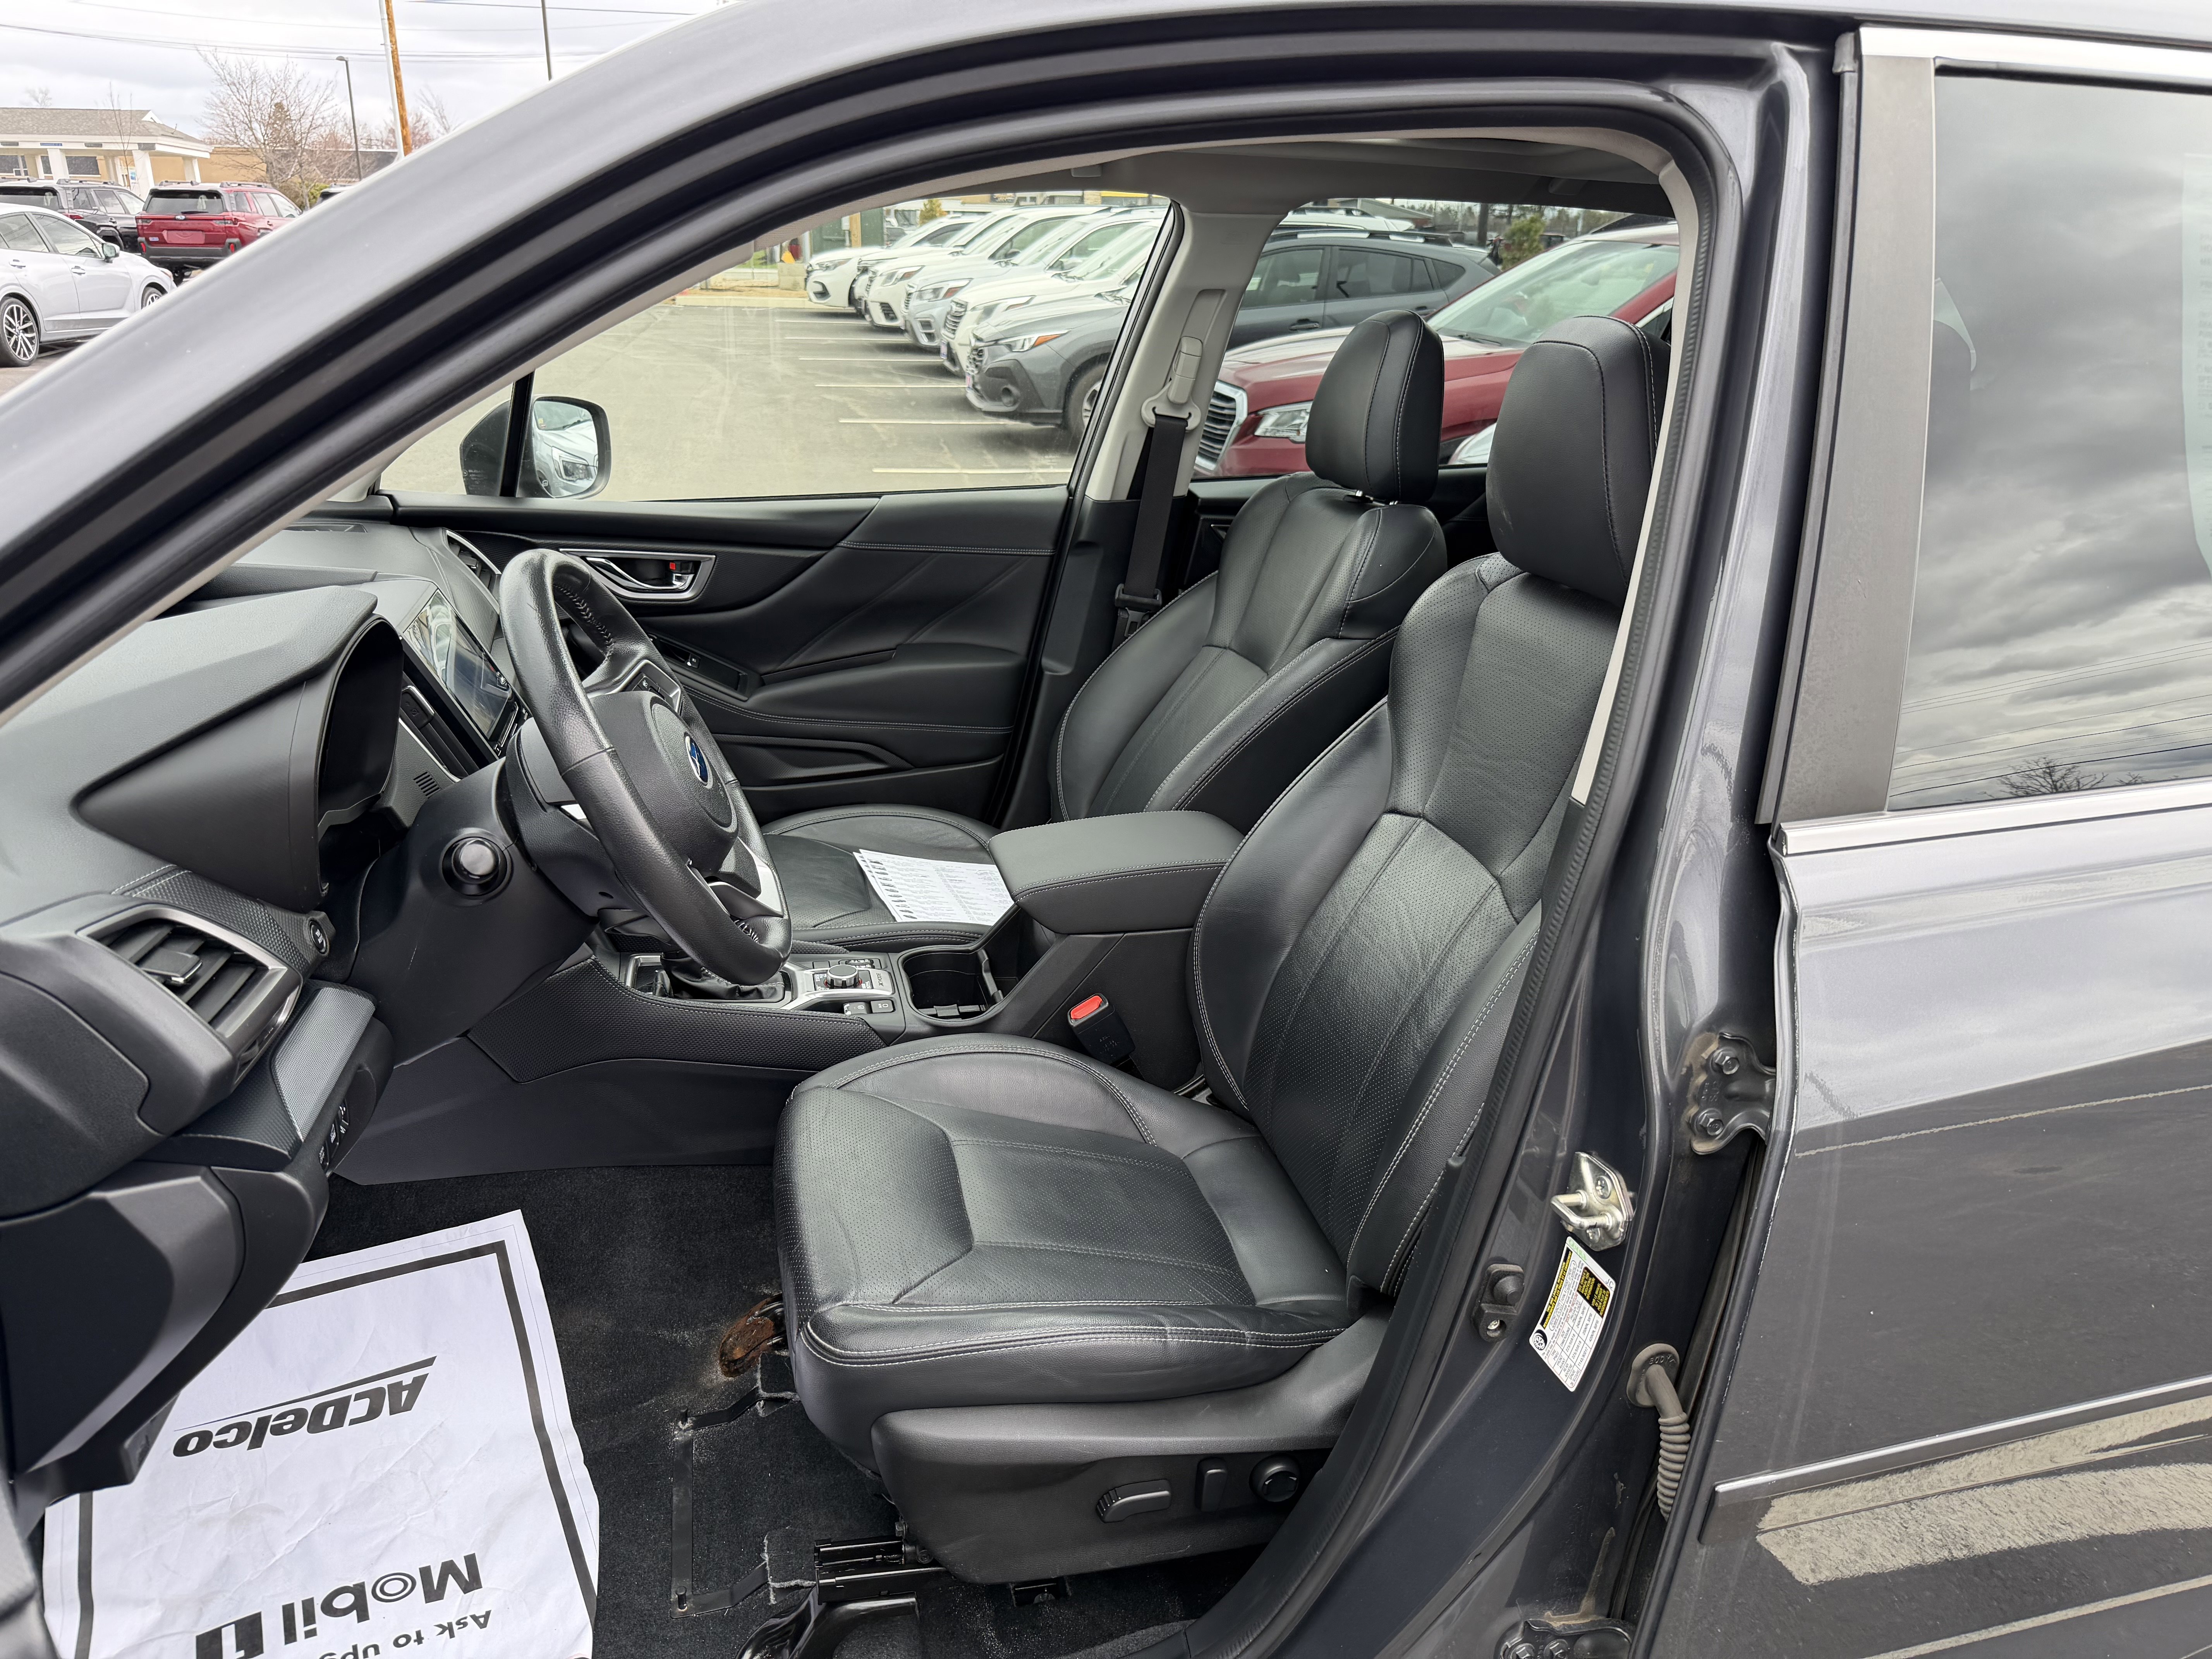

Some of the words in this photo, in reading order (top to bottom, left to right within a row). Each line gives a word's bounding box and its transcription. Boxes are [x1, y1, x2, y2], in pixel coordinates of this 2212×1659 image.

[173, 1373, 429, 1457] ACDelco
[282, 1553, 482, 1645] Mobil
[435, 1611, 491, 1638] Ask
[393, 1630, 424, 1648] to
